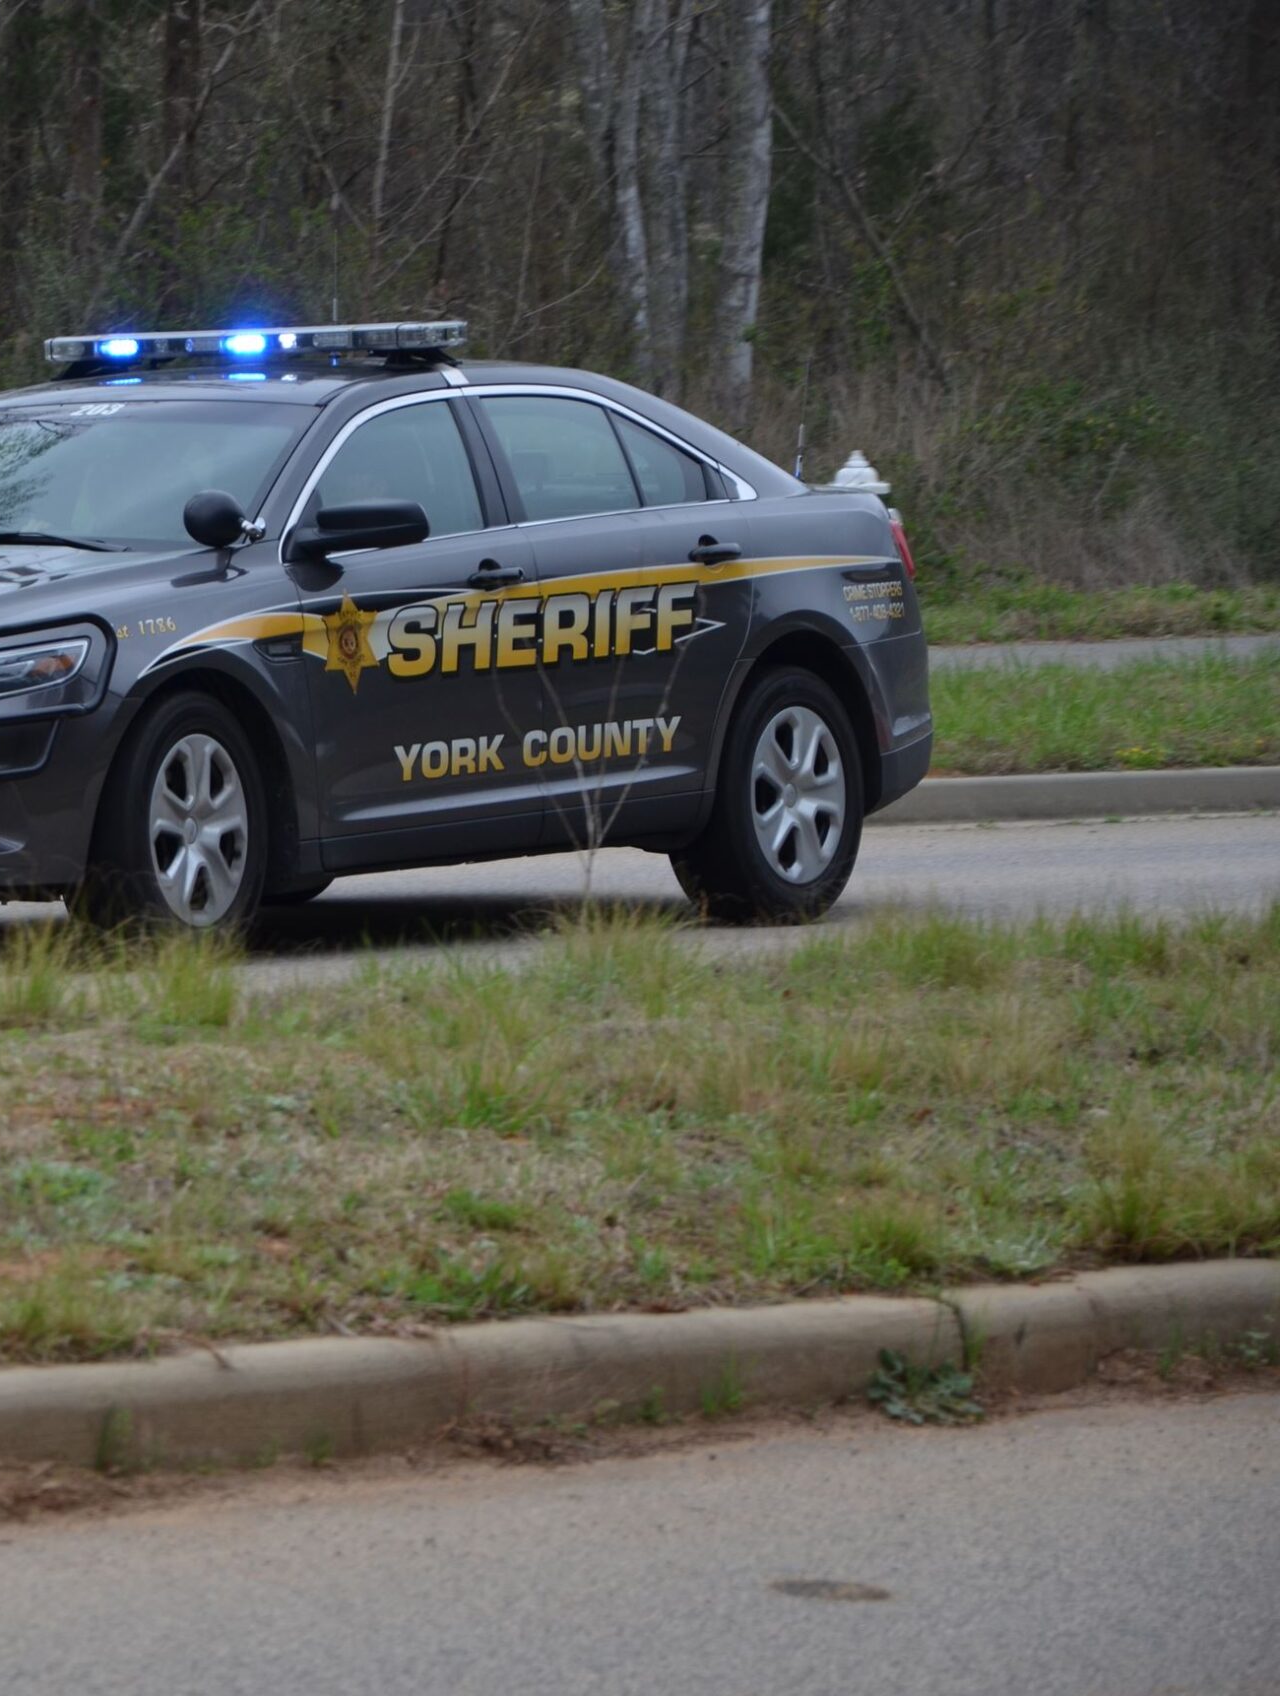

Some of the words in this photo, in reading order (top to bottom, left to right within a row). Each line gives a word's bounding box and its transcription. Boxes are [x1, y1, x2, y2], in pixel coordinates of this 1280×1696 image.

[70, 403, 125, 416] 203
[843, 584, 869, 601] CRIME
[867, 581, 903, 599] STOPPERS
[138, 616, 177, 635] 1786
[387, 581, 699, 678] SHERIFF
[394, 734, 505, 782] YORK
[522, 716, 682, 767] COUNTY
